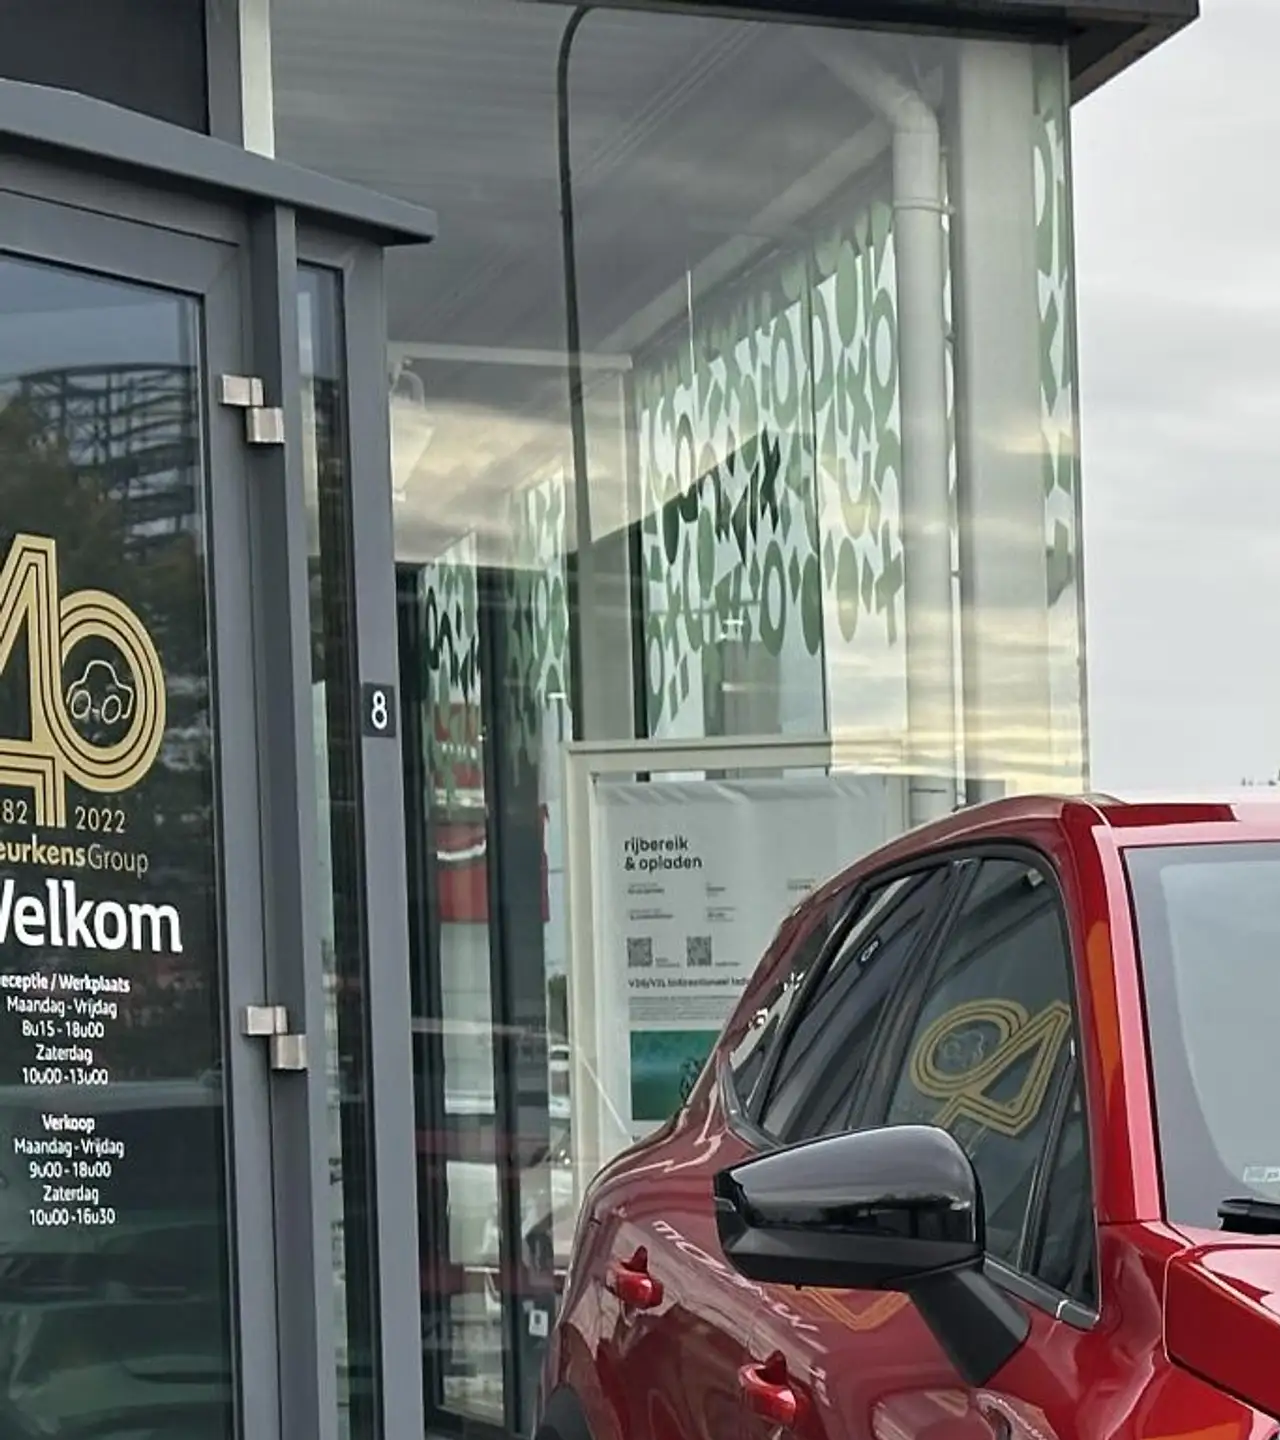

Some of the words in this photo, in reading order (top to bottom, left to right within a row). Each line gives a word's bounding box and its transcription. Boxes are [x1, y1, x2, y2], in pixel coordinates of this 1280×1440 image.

[371, 690, 388, 730] 8
[75, 806, 125, 834] 2022
[624, 835, 688, 856] rijbereik
[624, 856, 636, 872] &
[639, 855, 703, 875] opladen
[58, 973, 131, 995] Werkplaats
[7, 996, 65, 1018] Maandag
[73, 997, 117, 1020] Vrijdag
[22, 1020, 55, 1037] 8u15
[65, 1021, 105, 1038] 18u00
[35, 1043, 93, 1066] Zaterdag
[22, 1067, 62, 1084] 10u00
[69, 1068, 108, 1085] 13u00
[41, 1114, 95, 1134] Verkoop
[14, 1137, 73, 1158] Maandag
[80, 1137, 125, 1159] Vrijdag
[29, 1161, 62, 1178] 9u00
[72, 1161, 112, 1178] 18u00
[43, 1185, 99, 1210] Zaterdag
[29, 1208, 69, 1226] 10u00
[76, 1207, 116, 1225] 16u30
